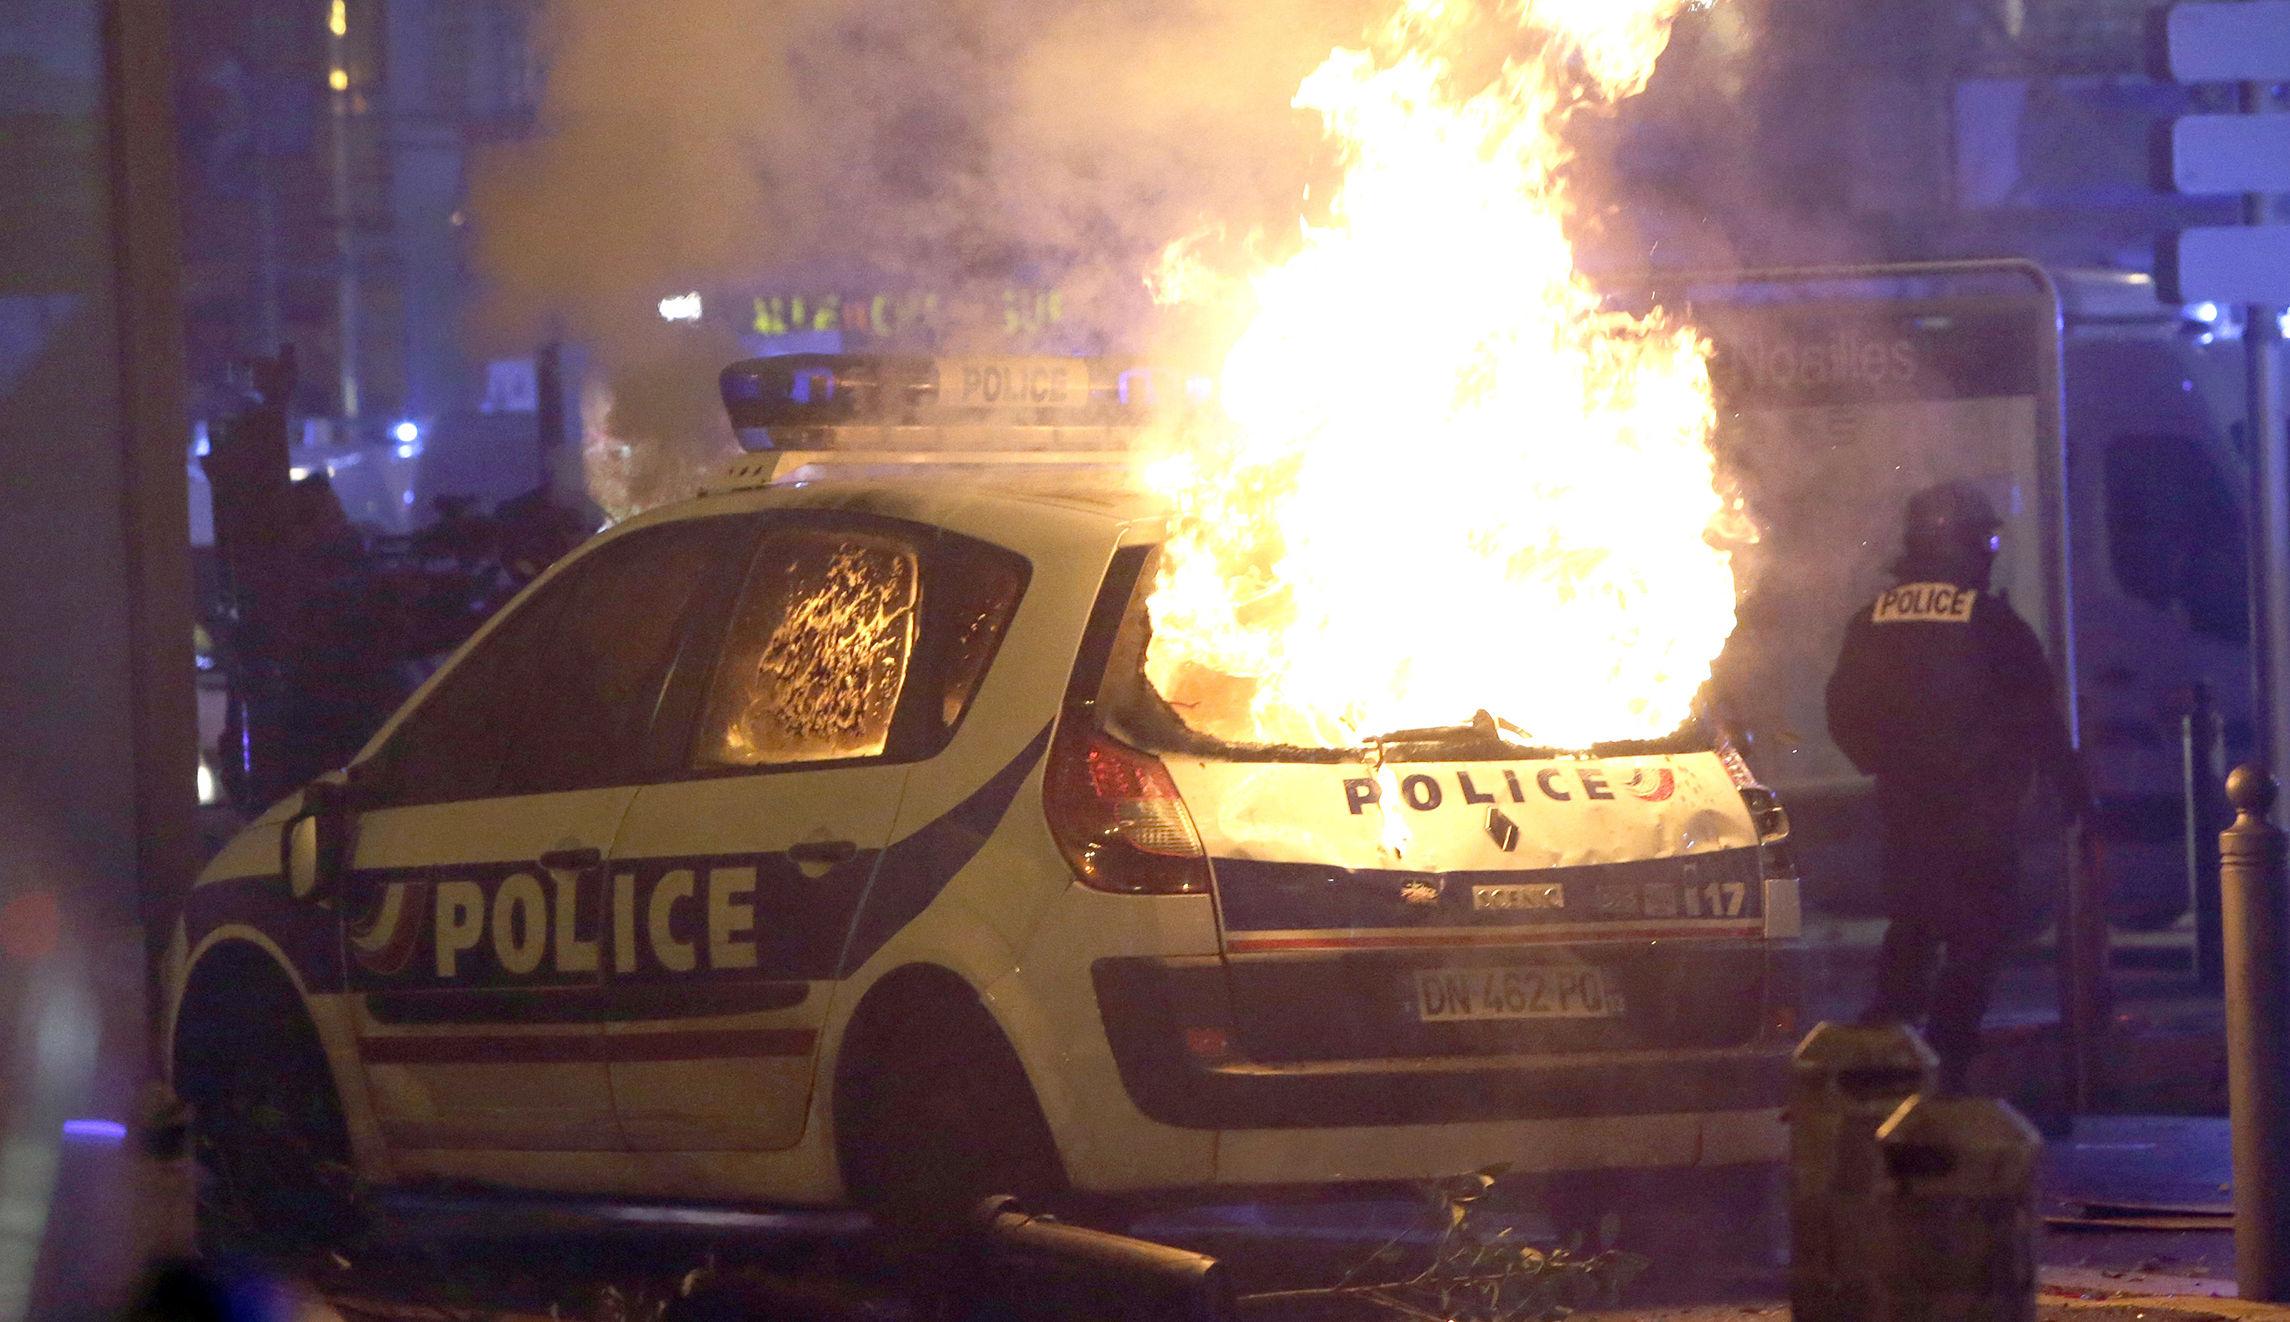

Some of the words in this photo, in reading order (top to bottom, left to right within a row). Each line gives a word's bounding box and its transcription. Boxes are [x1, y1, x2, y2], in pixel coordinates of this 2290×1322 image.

[962, 366, 1068, 403] POLICE
[1880, 588, 1965, 616] POLICE
[1343, 767, 1616, 816] POLICE
[434, 866, 758, 978] POLICE
[1421, 974, 1471, 1015] DN
[1478, 970, 1550, 1013] 462
